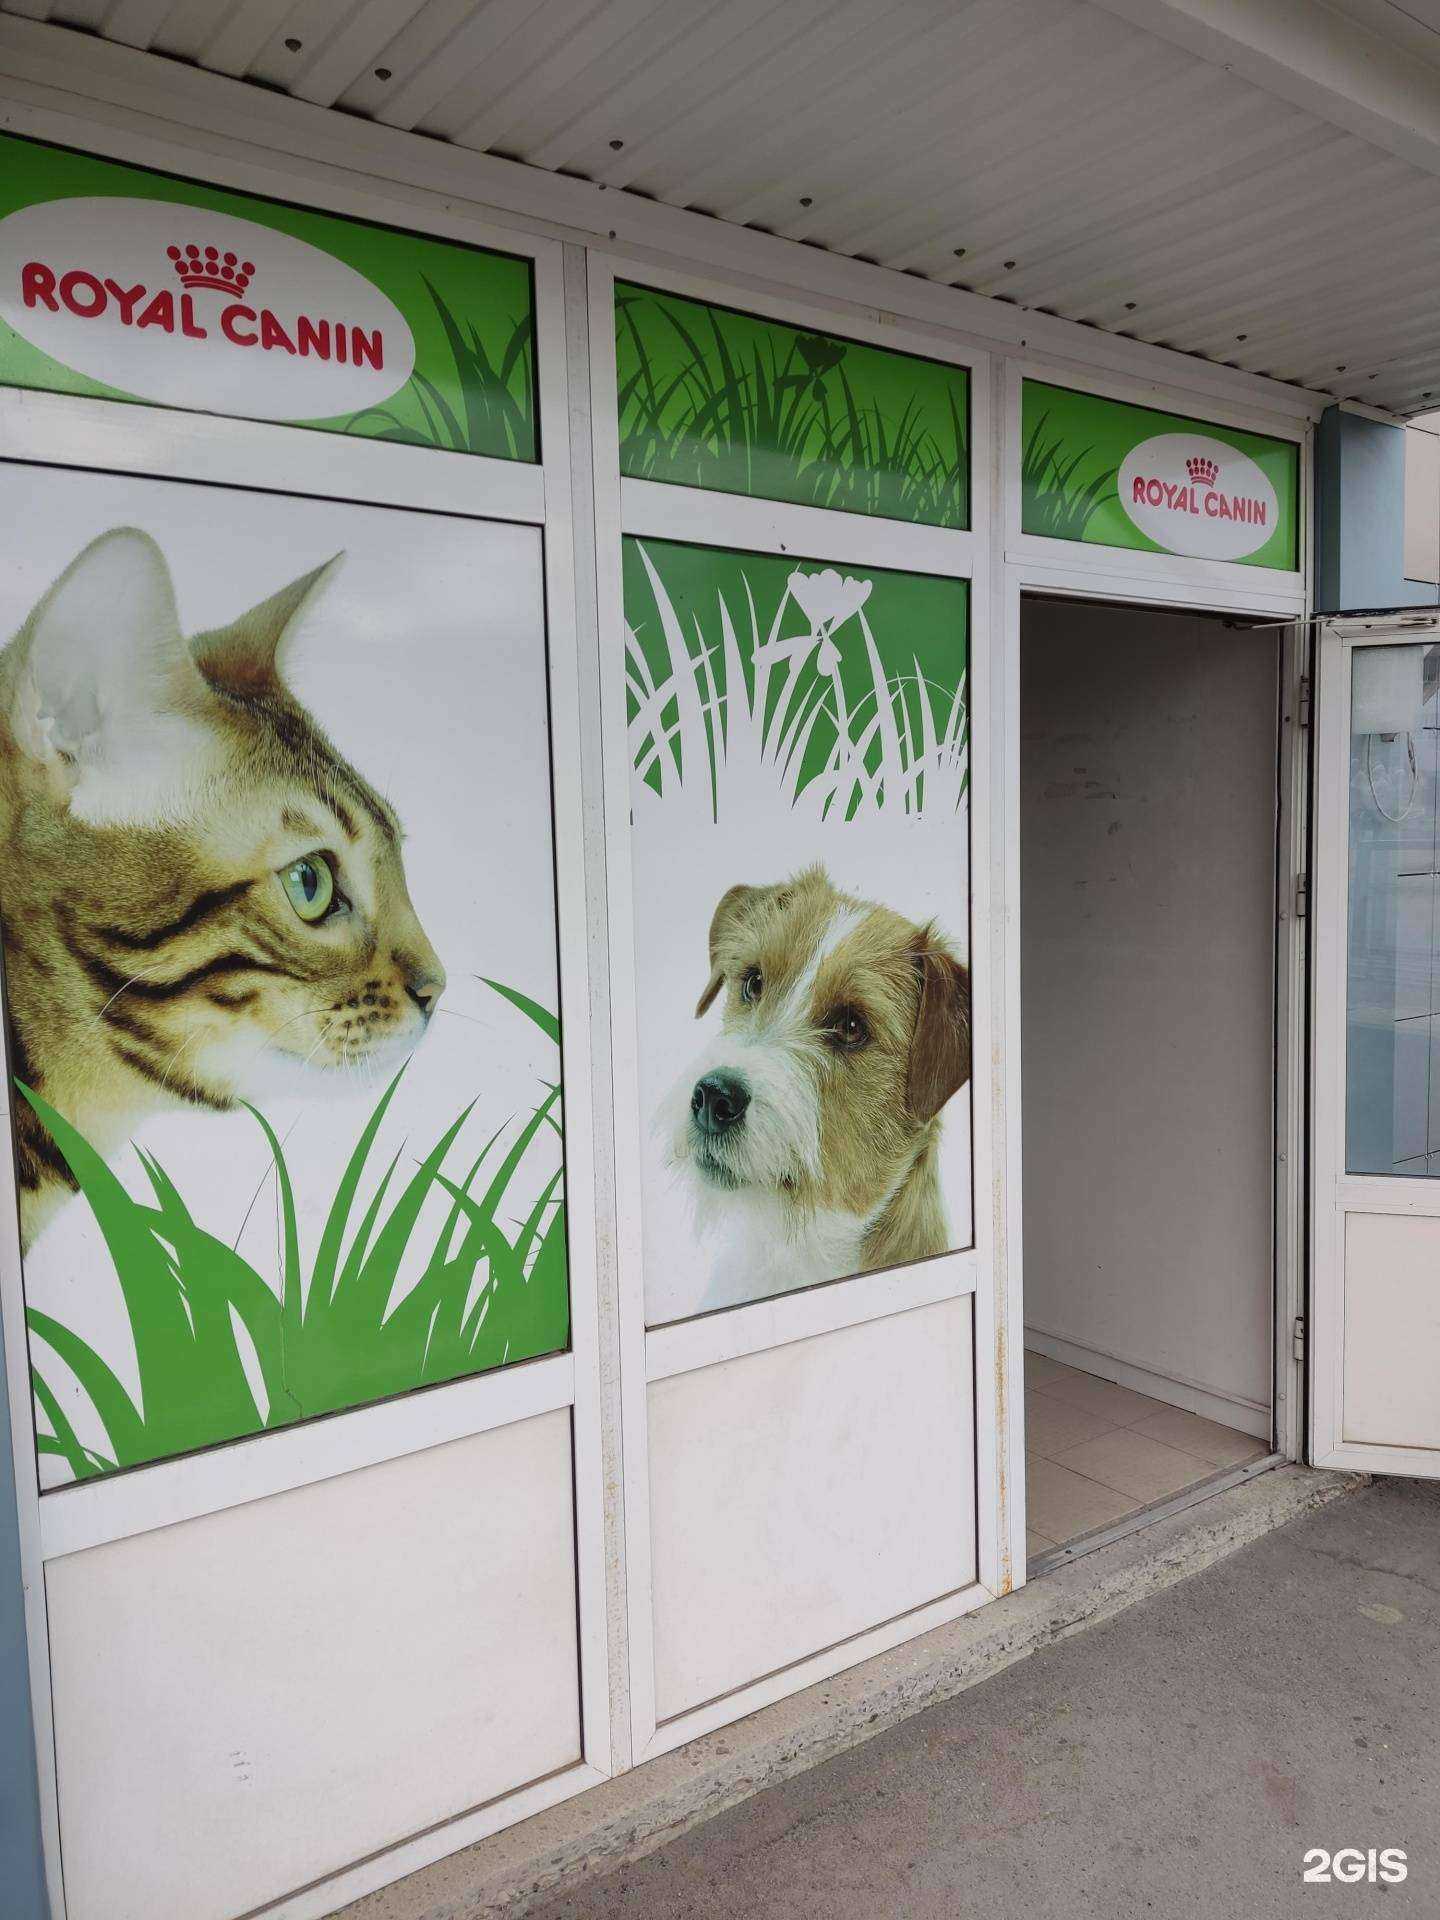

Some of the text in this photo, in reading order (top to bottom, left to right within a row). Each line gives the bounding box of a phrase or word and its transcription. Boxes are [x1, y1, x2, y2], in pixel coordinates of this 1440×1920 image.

[21, 262, 384, 371] ROYAL CANIN
[1133, 476, 1266, 526] ROYAL CANIN
